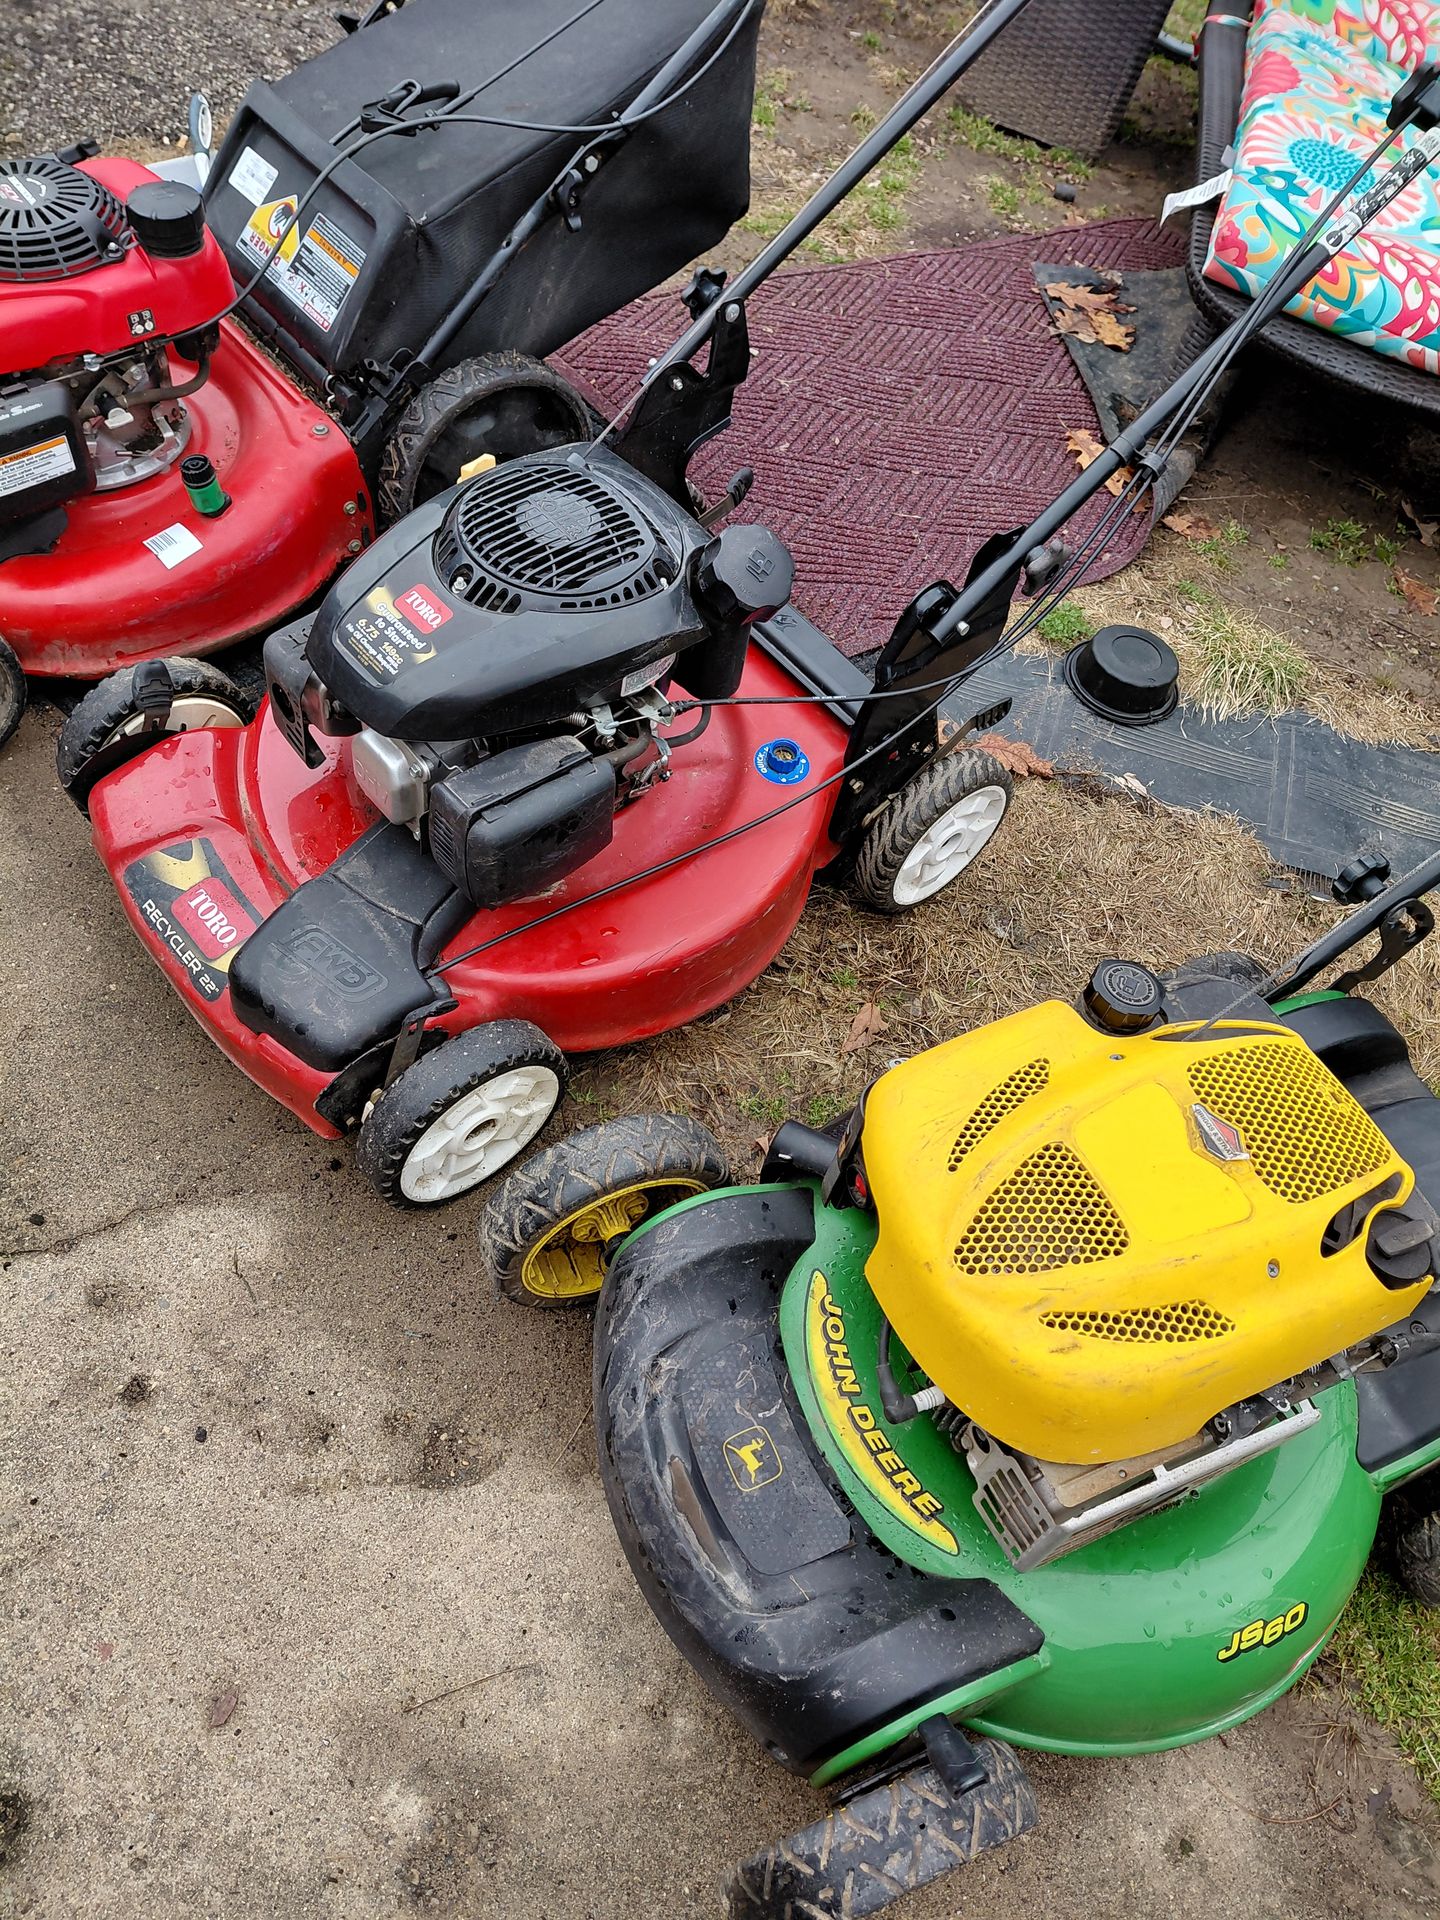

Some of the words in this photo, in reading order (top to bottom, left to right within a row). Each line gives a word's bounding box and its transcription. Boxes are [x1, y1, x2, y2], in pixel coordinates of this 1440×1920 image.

[249, 232, 280, 266] DNGER
[358, 618, 380, 640] 6.75
[375, 618, 386, 629] to
[376, 602, 426, 650] Guaranteed
[405, 590, 442, 626] TORO
[358, 636, 378, 656] Change
[142, 899, 204, 975] RECYCLER
[187, 887, 238, 944] TORO
[293, 936, 367, 987] FWD
[818, 1294, 861, 1400] JOHN
[846, 1403, 945, 1526] DEERE
[1217, 1601, 1309, 1663] JS60
